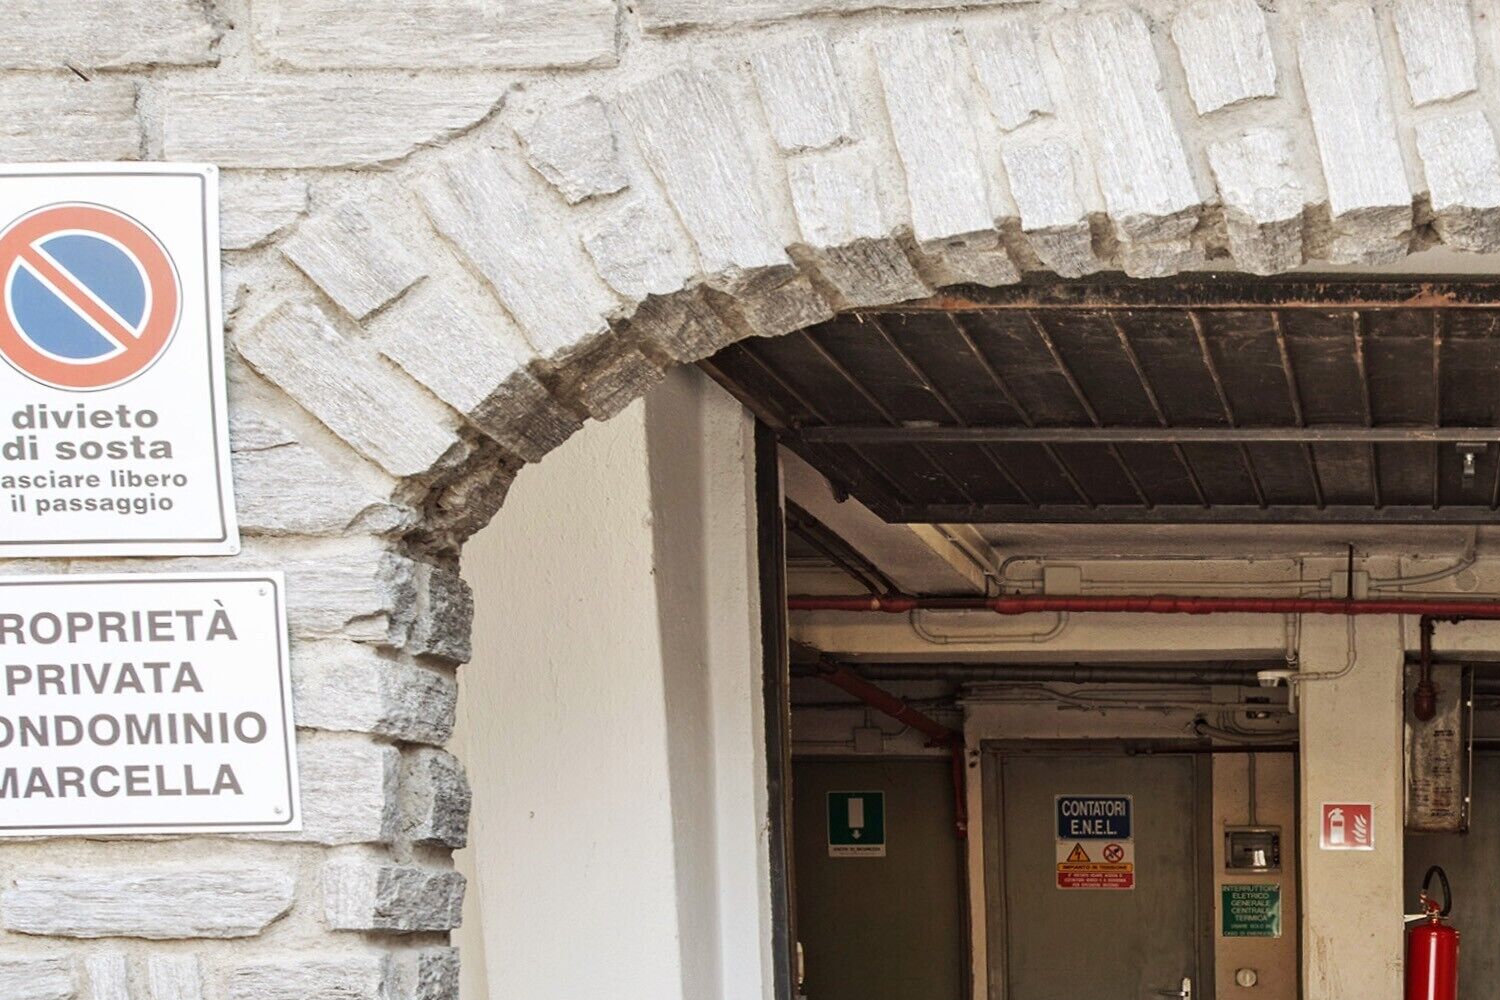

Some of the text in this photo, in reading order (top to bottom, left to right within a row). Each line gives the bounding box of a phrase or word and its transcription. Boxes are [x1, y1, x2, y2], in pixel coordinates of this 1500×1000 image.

[12, 403, 159, 429] divieto
[2, 435, 174, 461] di sosta
[1, 469, 188, 489] asciare libero
[11, 492, 174, 516] il passaggio
[0, 599, 238, 645] ROPRIETÀ
[5, 661, 204, 696] PRIVATA
[1061, 800, 1126, 816] CONTATORI
[1071, 819, 1117, 835] E.N.E.L.
[1230, 899, 1271, 907] GENERALE
[1234, 914, 1268, 922] TERMICA
